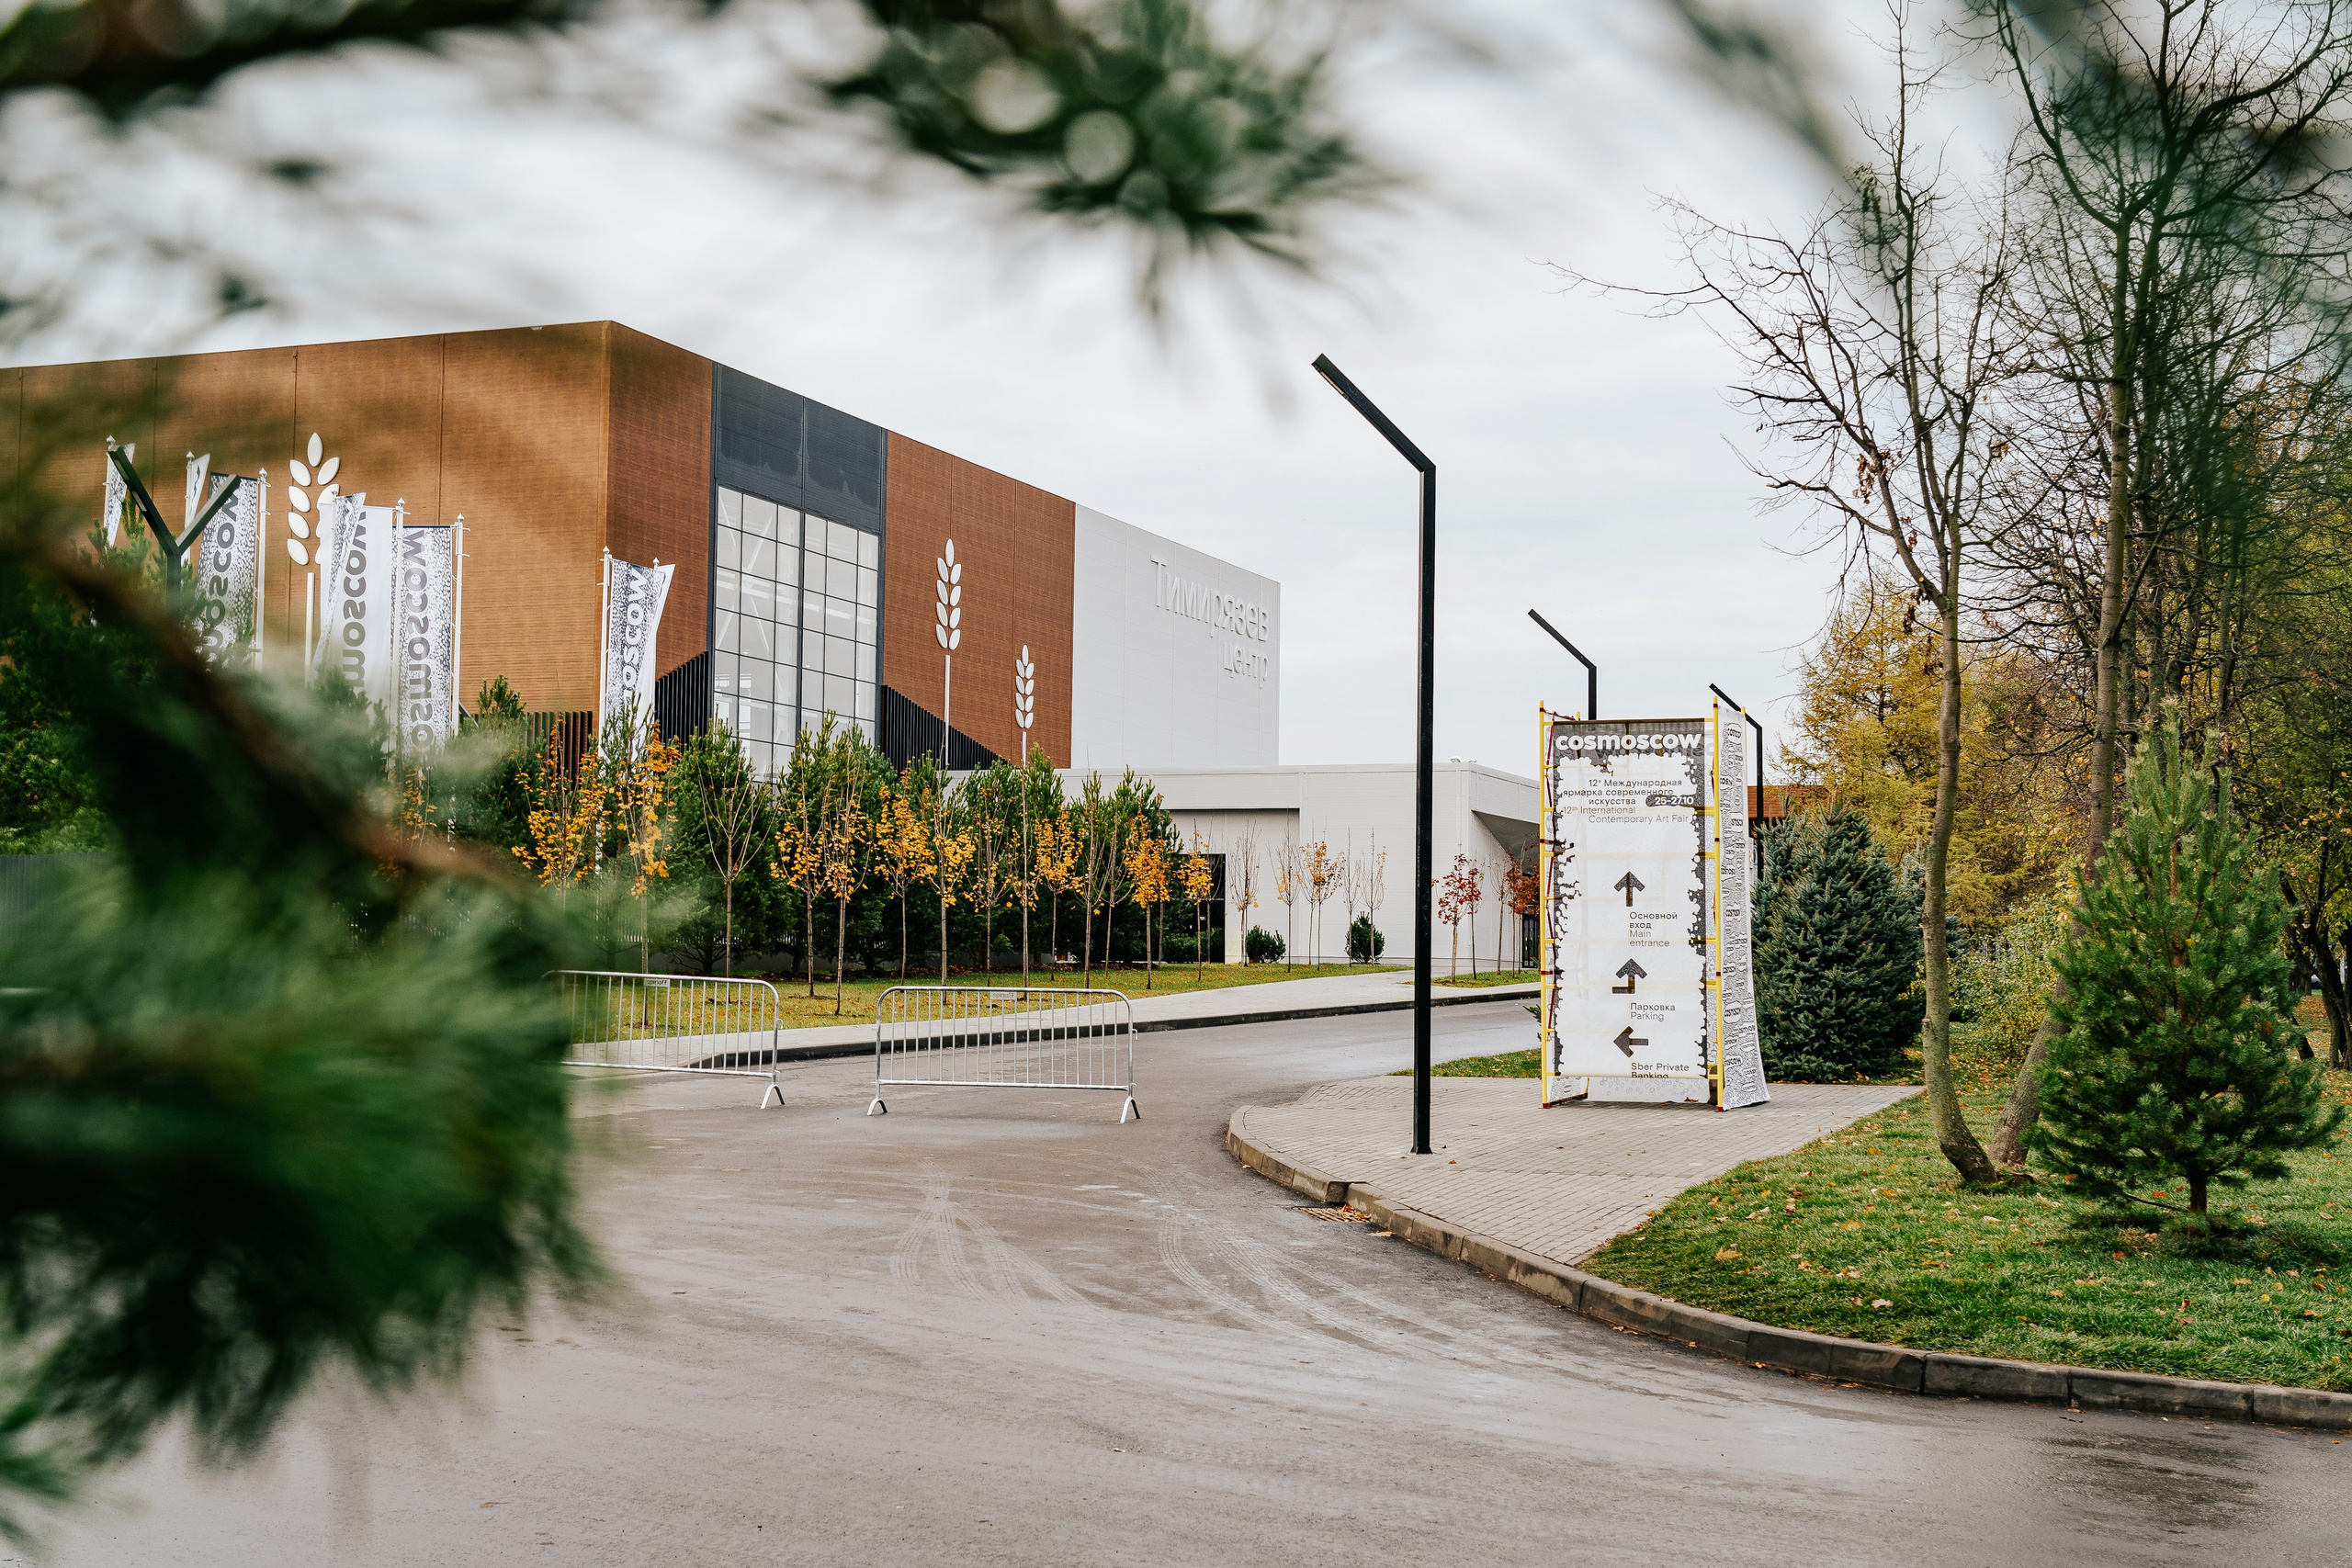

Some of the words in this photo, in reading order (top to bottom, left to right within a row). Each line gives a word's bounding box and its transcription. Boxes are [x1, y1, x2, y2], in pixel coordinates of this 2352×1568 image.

[1150, 555, 1270, 643] Тимирязев
[1223, 642, 1270, 690] центр
[1555, 733, 1702, 751] cosmoscow
[1604, 779, 1682, 789] Международная
[1563, 790, 1603, 798] ярмарка
[1605, 789, 1674, 797] современного
[1589, 798, 1636, 807] искусства
[1580, 806, 1635, 815] International
[1589, 814, 1654, 825] Contemporary
[1655, 814, 1669, 823] Art
[1671, 814, 1690, 823] Fair
[1629, 911, 1679, 919] Основной
[1629, 921, 1652, 930] вход
[1629, 930, 1652, 938] Main
[1630, 1002, 1676, 1013] Парковка
[1630, 1011, 1665, 1021] Parking
[1631, 1062, 1654, 1071] Sber
[1656, 1063, 1690, 1072] Private
